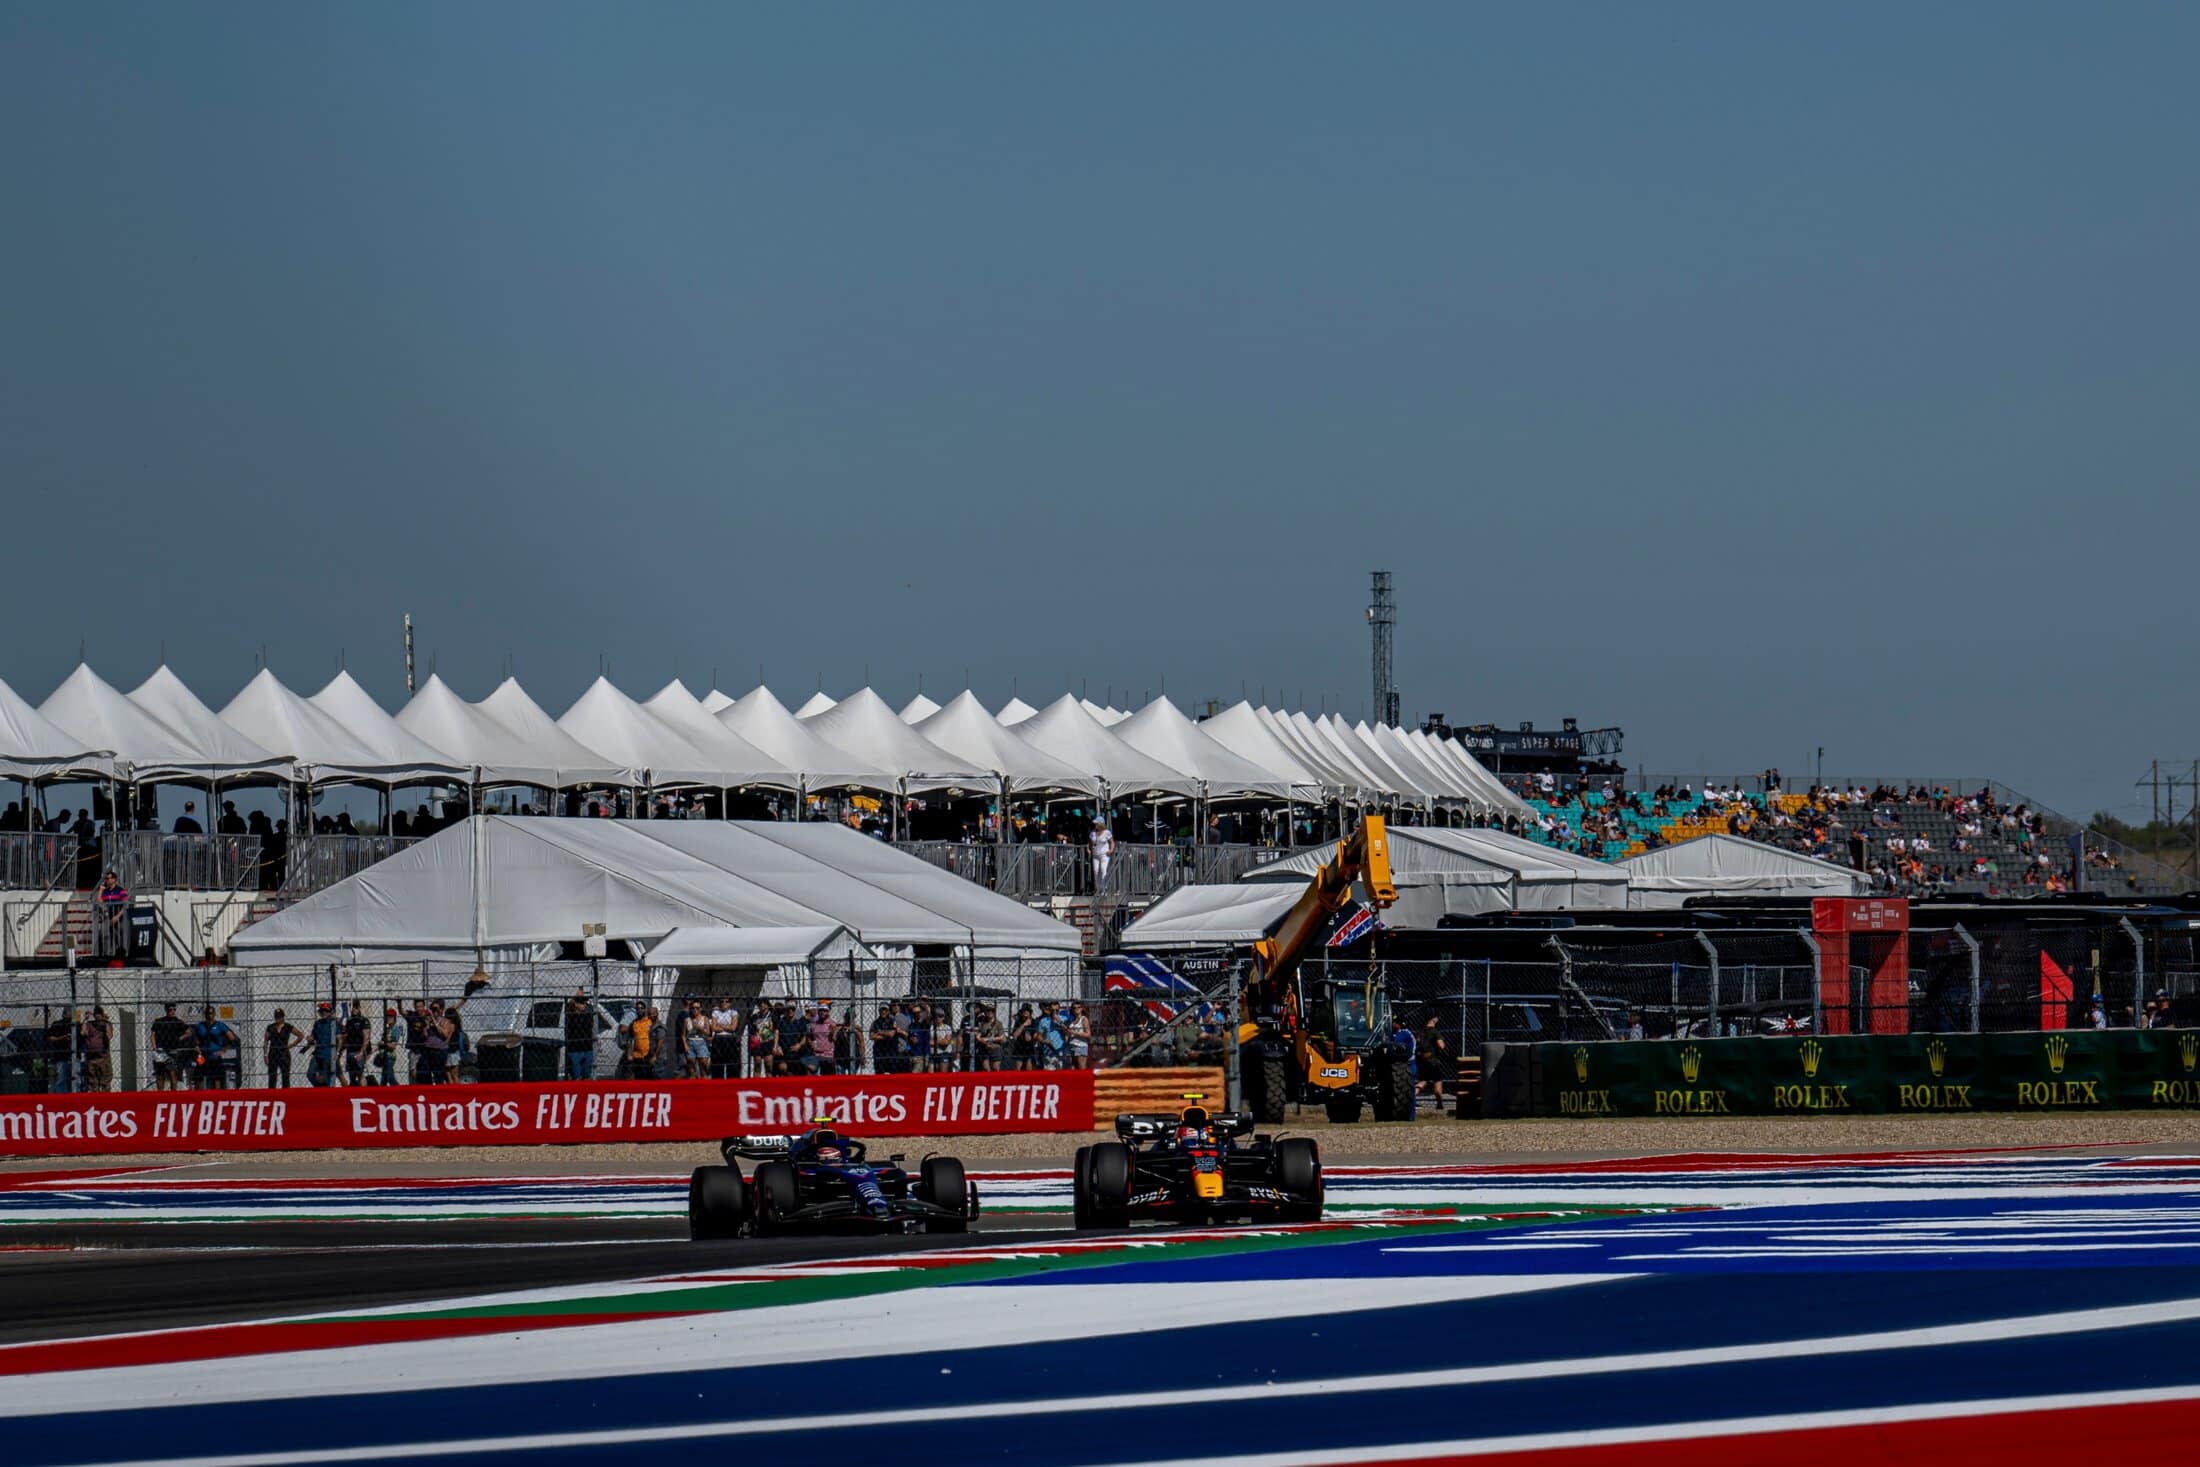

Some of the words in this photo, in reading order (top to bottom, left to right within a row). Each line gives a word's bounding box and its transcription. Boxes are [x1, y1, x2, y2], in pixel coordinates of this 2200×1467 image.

[1521, 737, 1550, 749] SUPER
[1183, 961, 1219, 969] AUSTIN
[1321, 1069, 1348, 1078] JCB
[1560, 1090, 1612, 1113] ROLEX
[1655, 1090, 1729, 1113] ROLEX
[1774, 1085, 1850, 1109] ROLEX
[1900, 1085, 1972, 1108] ROLEX
[2018, 1081, 2099, 1105] ROLEX
[350, 1095, 519, 1133] Emirates
[535, 1094, 577, 1129] FLY
[584, 1093, 671, 1128] BETTER
[736, 1088, 907, 1126] Emirates
[922, 1086, 964, 1122] FLY
[970, 1084, 1060, 1121] BETTER
[0, 1104, 138, 1140] mirates
[153, 1103, 195, 1138] FLY
[197, 1101, 286, 1136] BETTER
